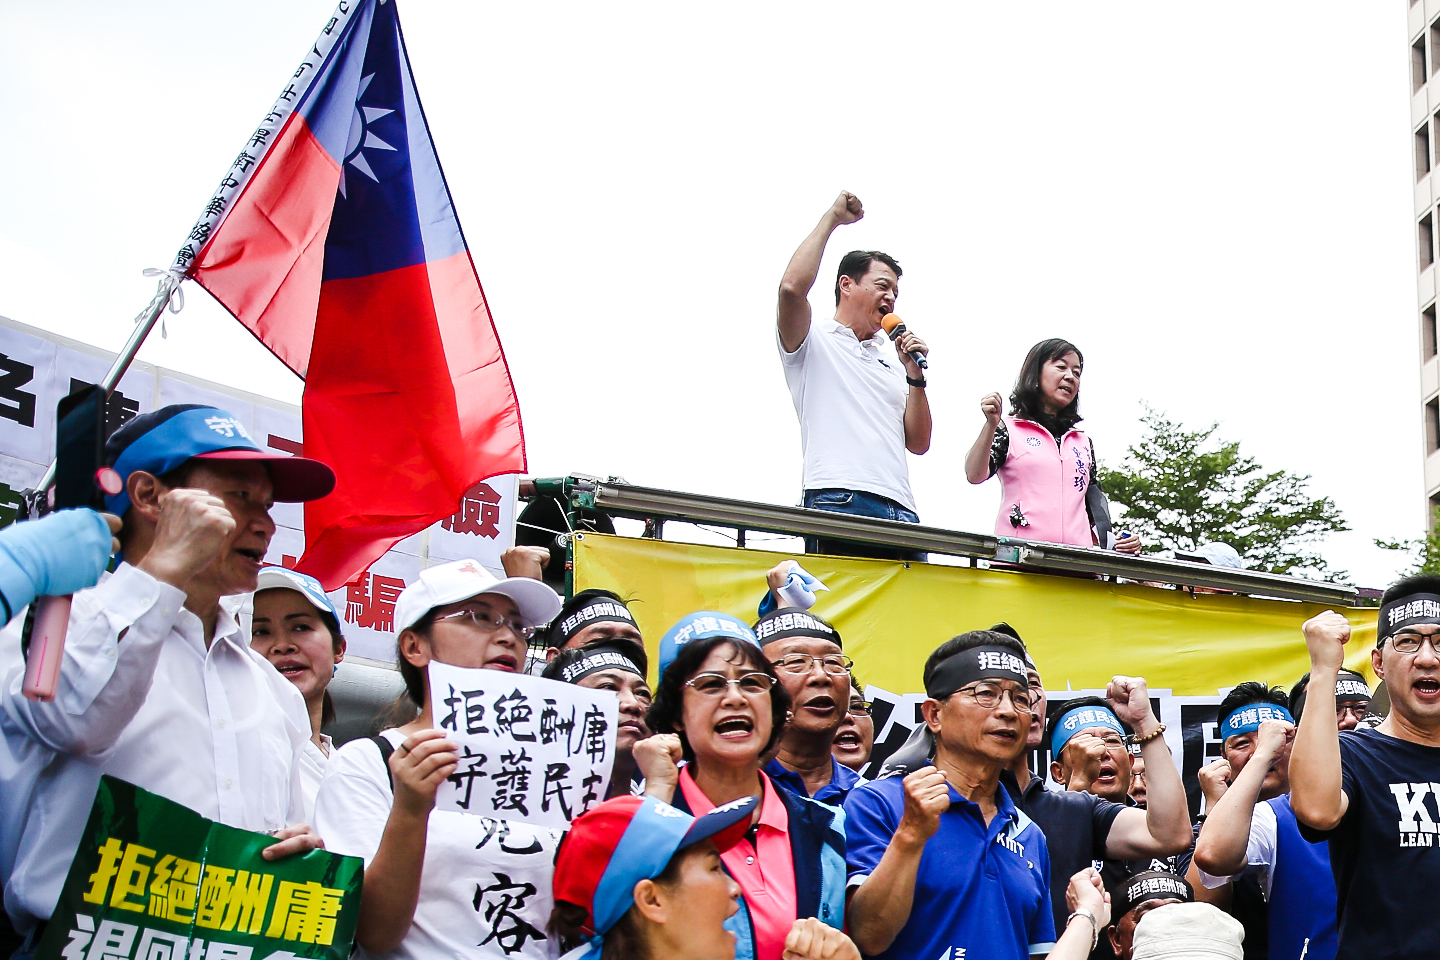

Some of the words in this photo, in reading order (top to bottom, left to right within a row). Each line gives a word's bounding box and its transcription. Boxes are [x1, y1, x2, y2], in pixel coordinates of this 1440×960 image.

[440, 683, 608, 764] 拒絕酬庸
[1064, 710, 1123, 731] 守護民主
[449, 746, 603, 822] 守護民主
[996, 832, 1027, 858] KMT
[1400, 832, 1433, 848] LEAN
[84, 838, 344, 947] 拒絕酬庸
[1127, 877, 1188, 903] 拒絕酬庸
